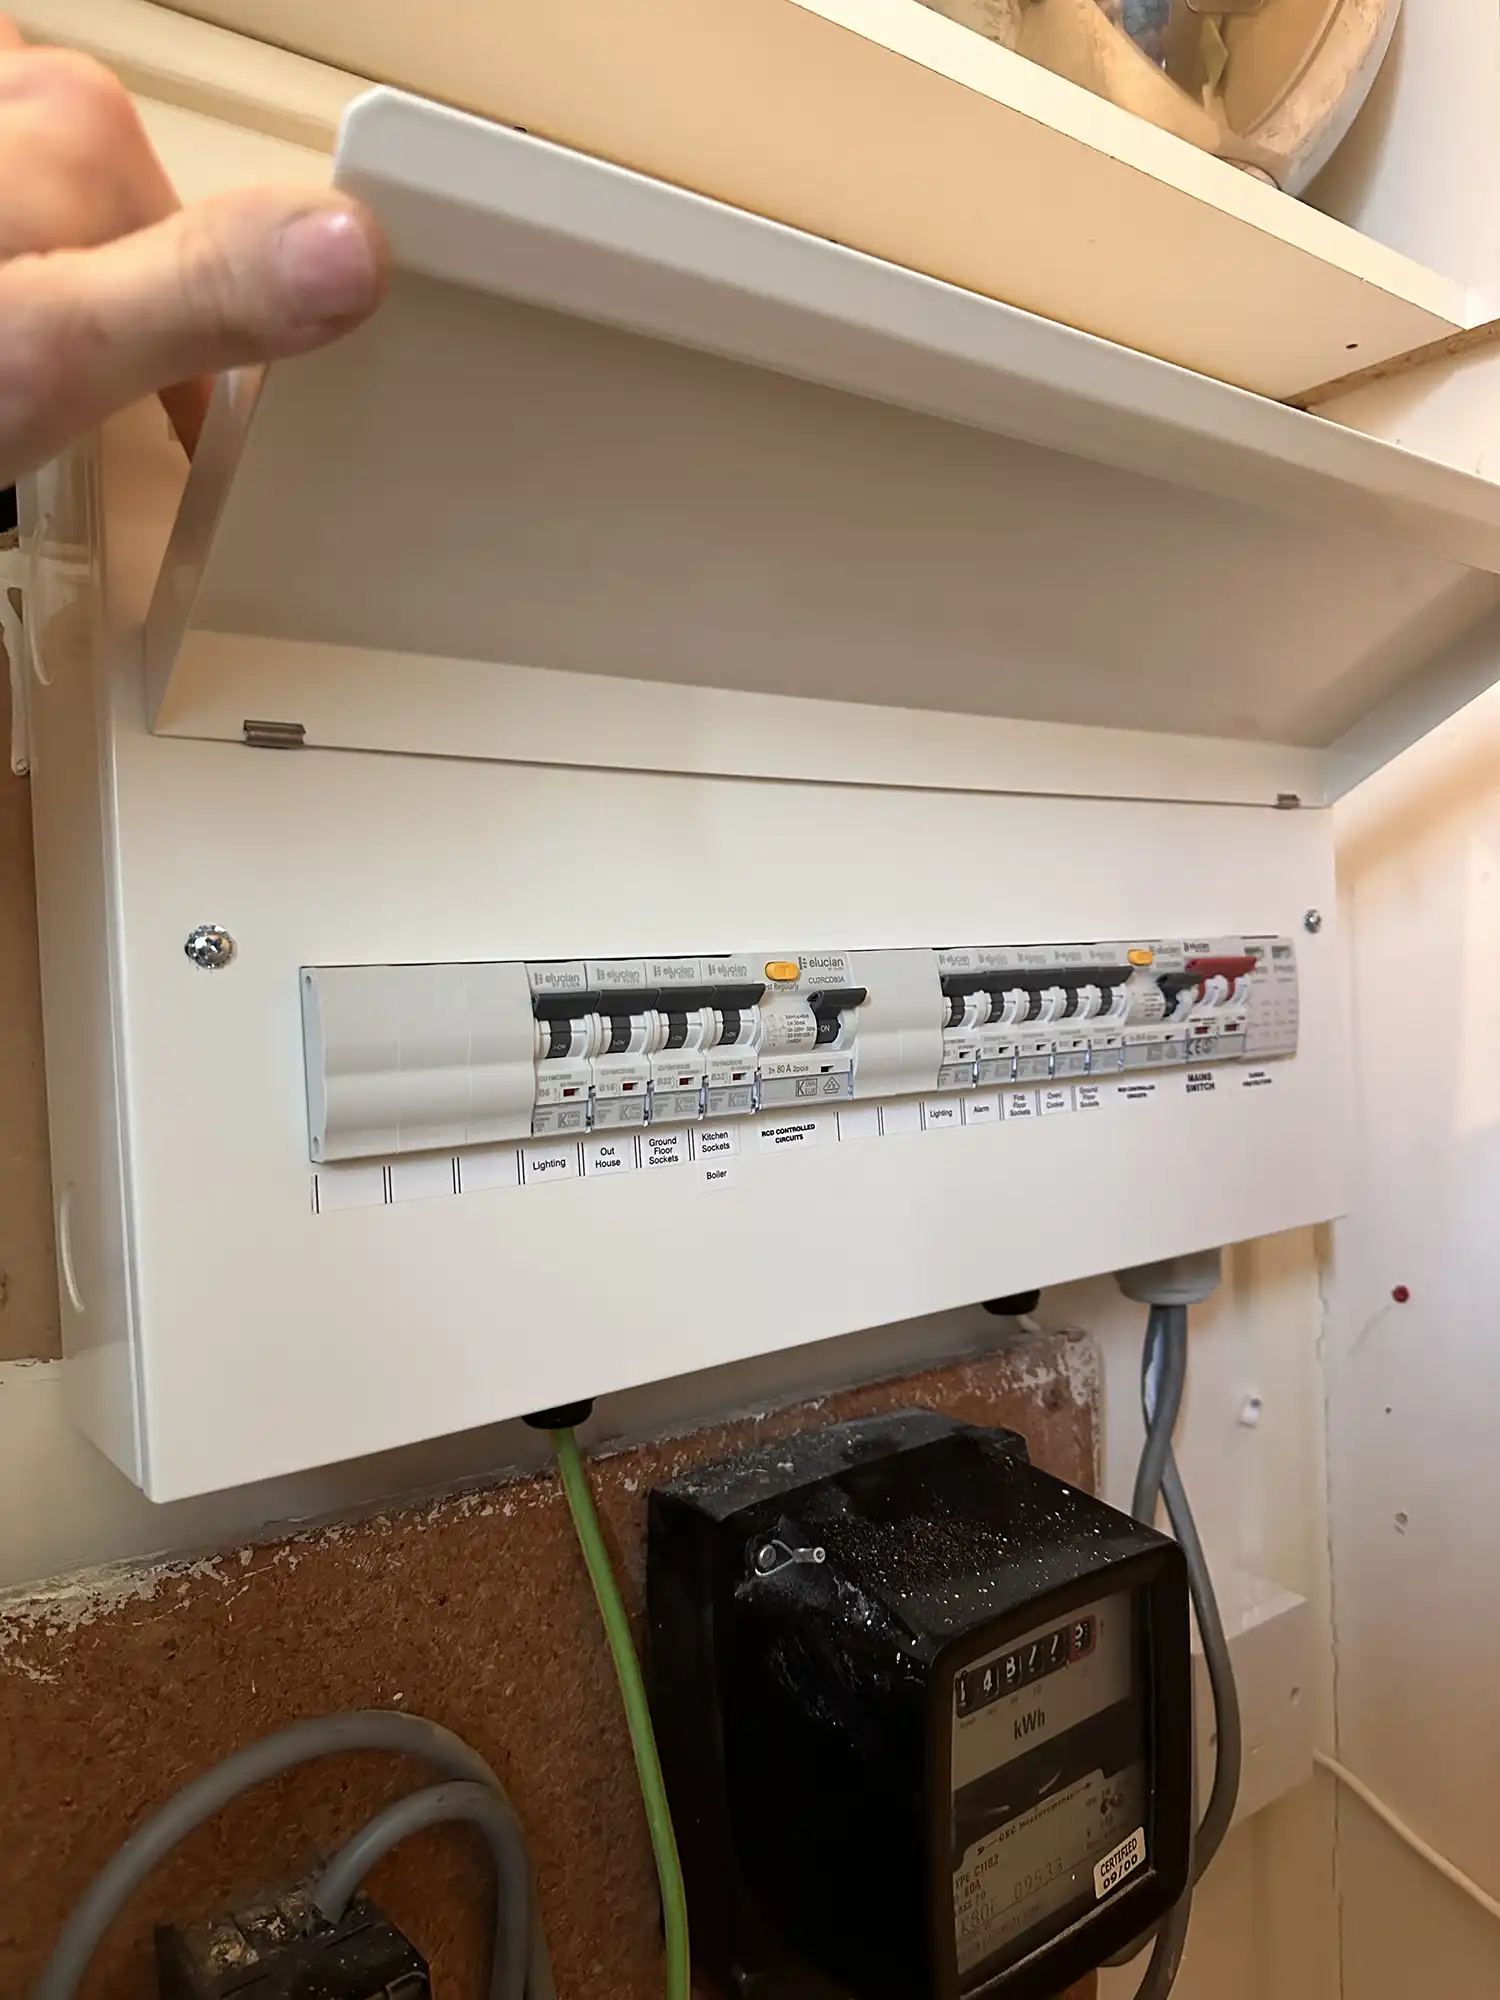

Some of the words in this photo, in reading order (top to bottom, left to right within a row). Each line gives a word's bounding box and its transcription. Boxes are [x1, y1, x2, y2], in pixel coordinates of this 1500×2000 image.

[809, 957, 844, 968] elucian
[774, 982, 799, 992] Regularly
[777, 1065, 785, 1074] 80
[1187, 1073, 1212, 1082] MAINS
[1186, 1082, 1215, 1093] SWITCH
[930, 1109, 953, 1119] Lighting
[761, 1129, 775, 1138] RCD
[775, 1123, 816, 1135] CONTROLLED
[702, 1131, 729, 1141] Kitchen
[775, 1134, 804, 1144] CIRCUITS
[649, 1136, 677, 1147] Ground
[600, 1147, 615, 1156] Out
[653, 1146, 673, 1156] Floor
[702, 1143, 730, 1153] Sockets
[532, 1158, 566, 1171] Lighting
[595, 1159, 621, 1168] House
[649, 1155, 679, 1165] Sockets
[706, 1170, 727, 1180] Boiler
[1014, 1706, 1045, 1740] kWh
[1100, 1836, 1138, 1877] CERTIFIED
[1103, 1853, 1139, 1890] 09/00
[954, 1871, 972, 1890] YPE
